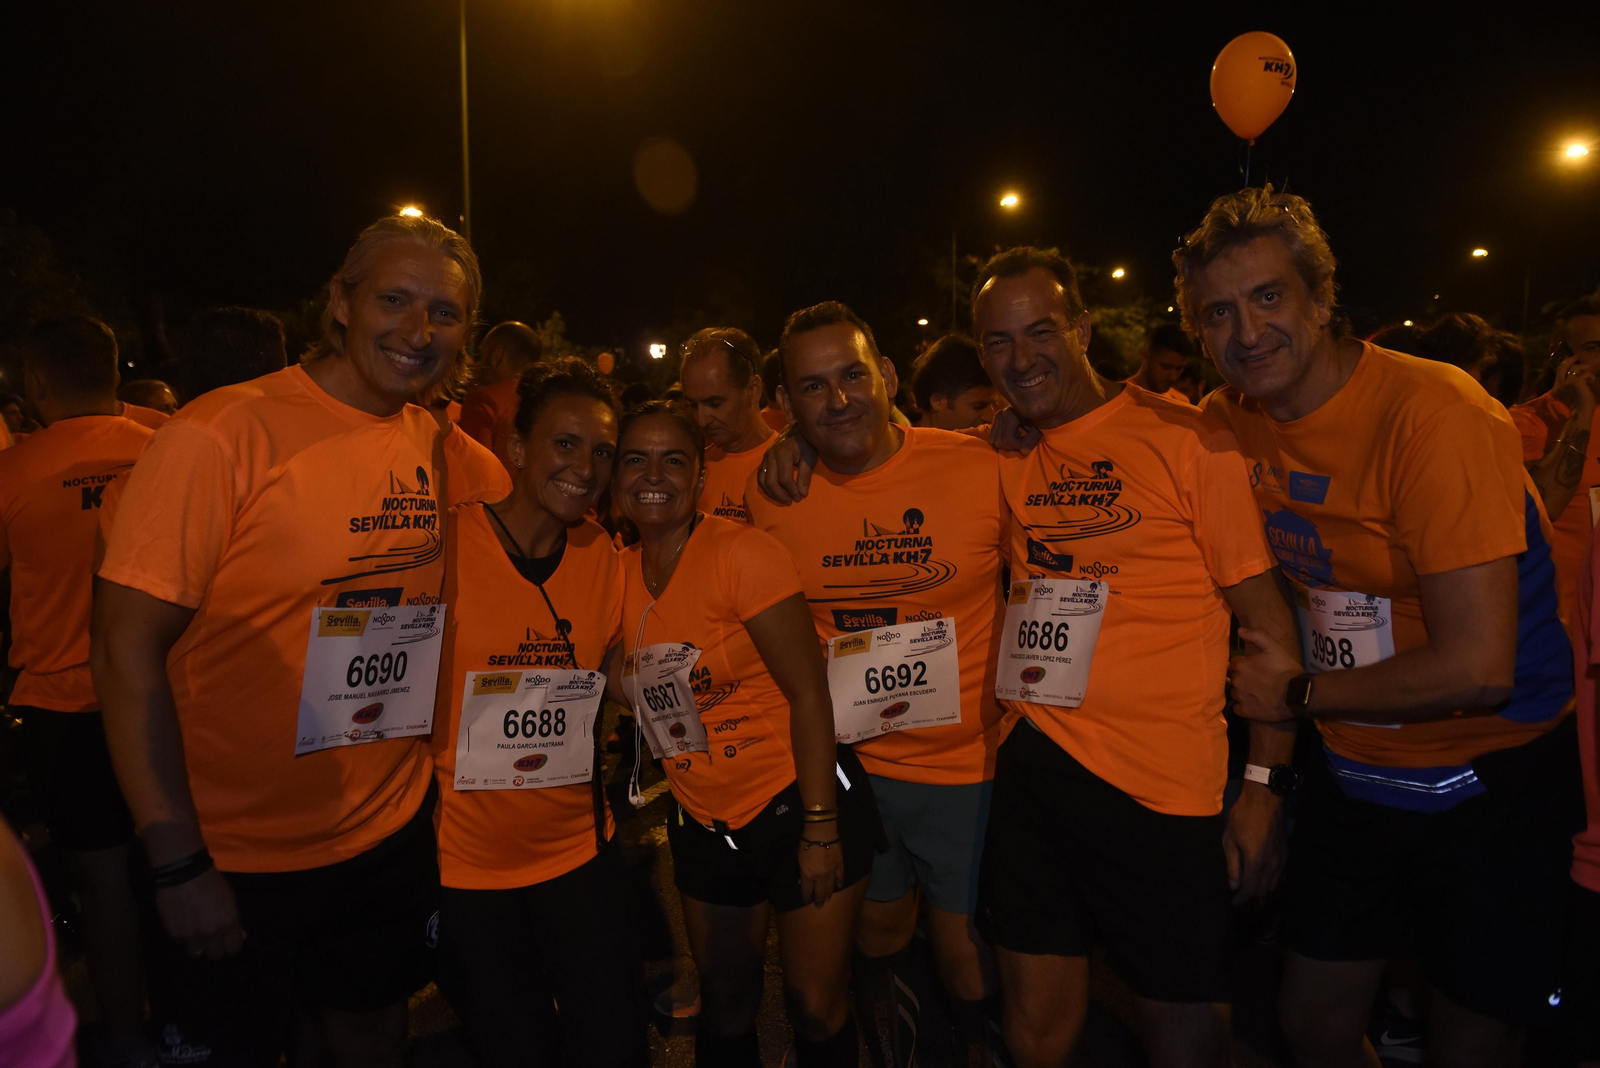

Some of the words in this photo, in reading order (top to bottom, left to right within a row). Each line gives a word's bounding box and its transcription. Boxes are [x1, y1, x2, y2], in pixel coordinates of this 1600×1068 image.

[1263, 61, 1291, 76] KH7
[1050, 480, 1122, 493] NOCTURNA
[381, 497, 437, 512] NOCTURNA
[1025, 493, 1077, 506] SEVILLA
[1078, 492, 1121, 507] KH7
[349, 515, 410, 533] SEVILLA
[412, 513, 437, 531] KH7
[854, 535, 933, 551] NOCTURNA
[1268, 526, 1319, 557] SEVILLA
[821, 552, 889, 568] SEVILLA
[892, 549, 933, 564] KH7
[1060, 596, 1083, 604] SEVILLA
[909, 636, 933, 644] SEVILLA
[920, 629, 947, 637] NOCTURNA
[1018, 620, 1070, 651] 6686
[517, 642, 575, 653] NOCTURNA
[1312, 629, 1356, 669] 3998
[487, 654, 545, 666] SEVILLA
[545, 653, 573, 666] KH7
[346, 651, 408, 688] 6690
[864, 661, 928, 694] 6692
[327, 693, 343, 702] JOSE
[343, 692, 367, 700] MANUEL
[367, 688, 389, 698] NAVARRO
[643, 682, 681, 712] 6687
[867, 696, 889, 704] ENRIQUE
[889, 691, 909, 700] PUYANA
[909, 688, 937, 697] ESCUDERO
[503, 708, 567, 738] 6688
[516, 758, 542, 768] KH7
